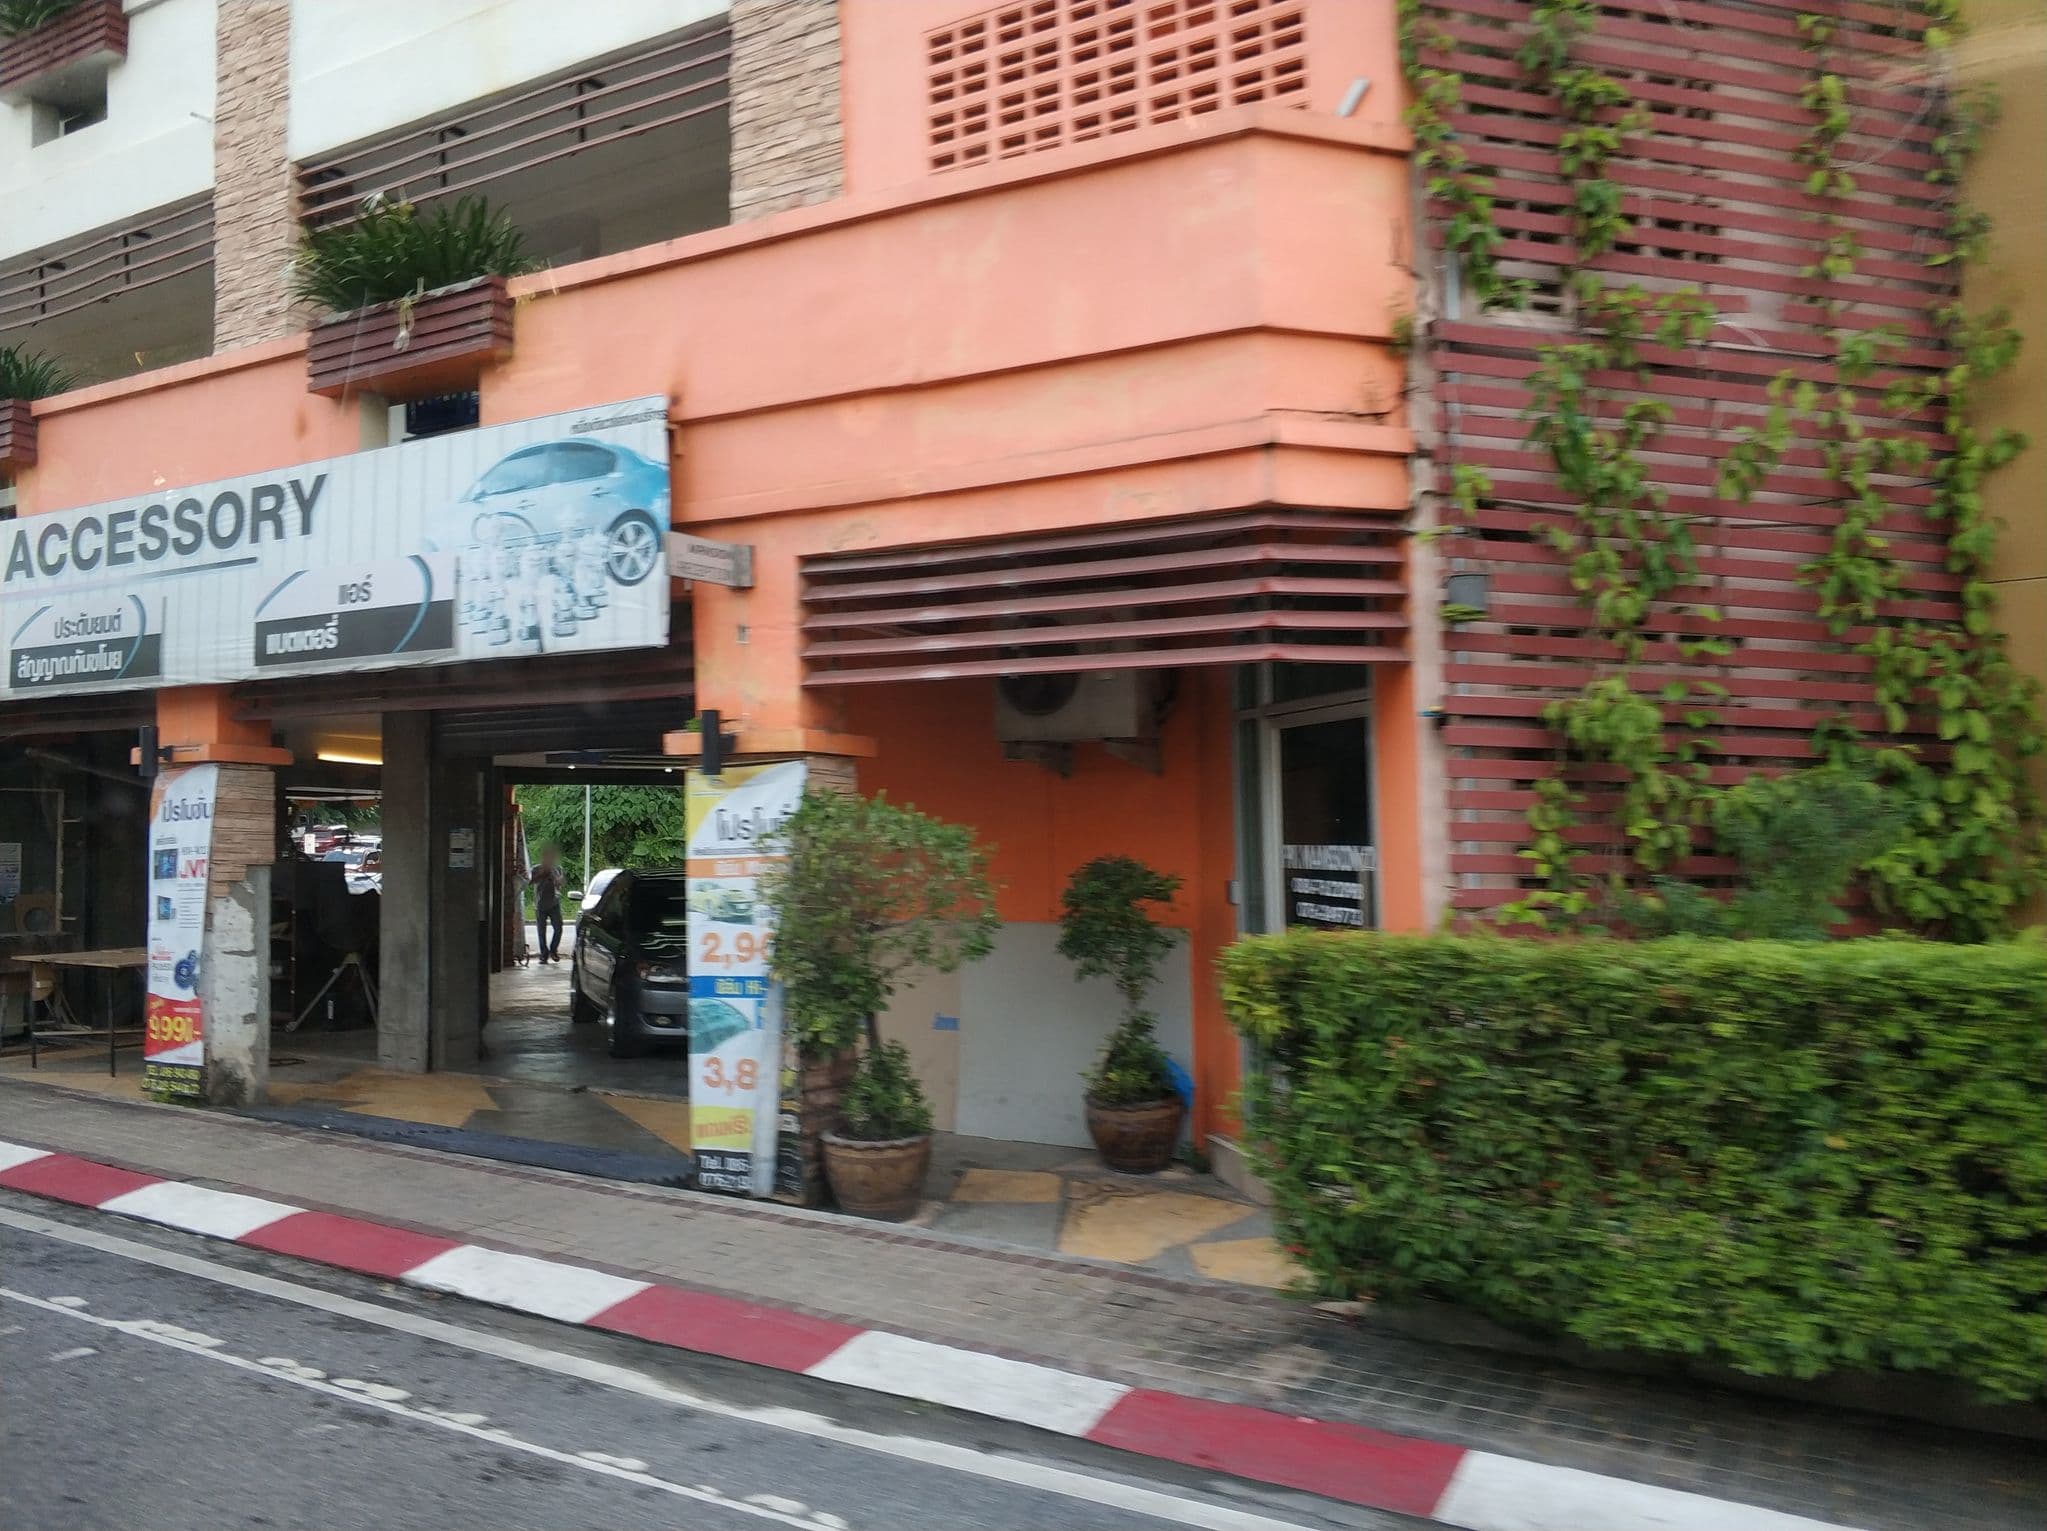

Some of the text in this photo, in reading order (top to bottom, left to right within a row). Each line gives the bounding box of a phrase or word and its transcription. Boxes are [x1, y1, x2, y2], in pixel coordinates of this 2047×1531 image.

[4, 473, 328, 582] ACCESSORY
[338, 573, 373, 605] แอร์
[266, 614, 339, 655] แบตเตอรี่
[17, 643, 123, 682] สัญญาณกันขโมย
